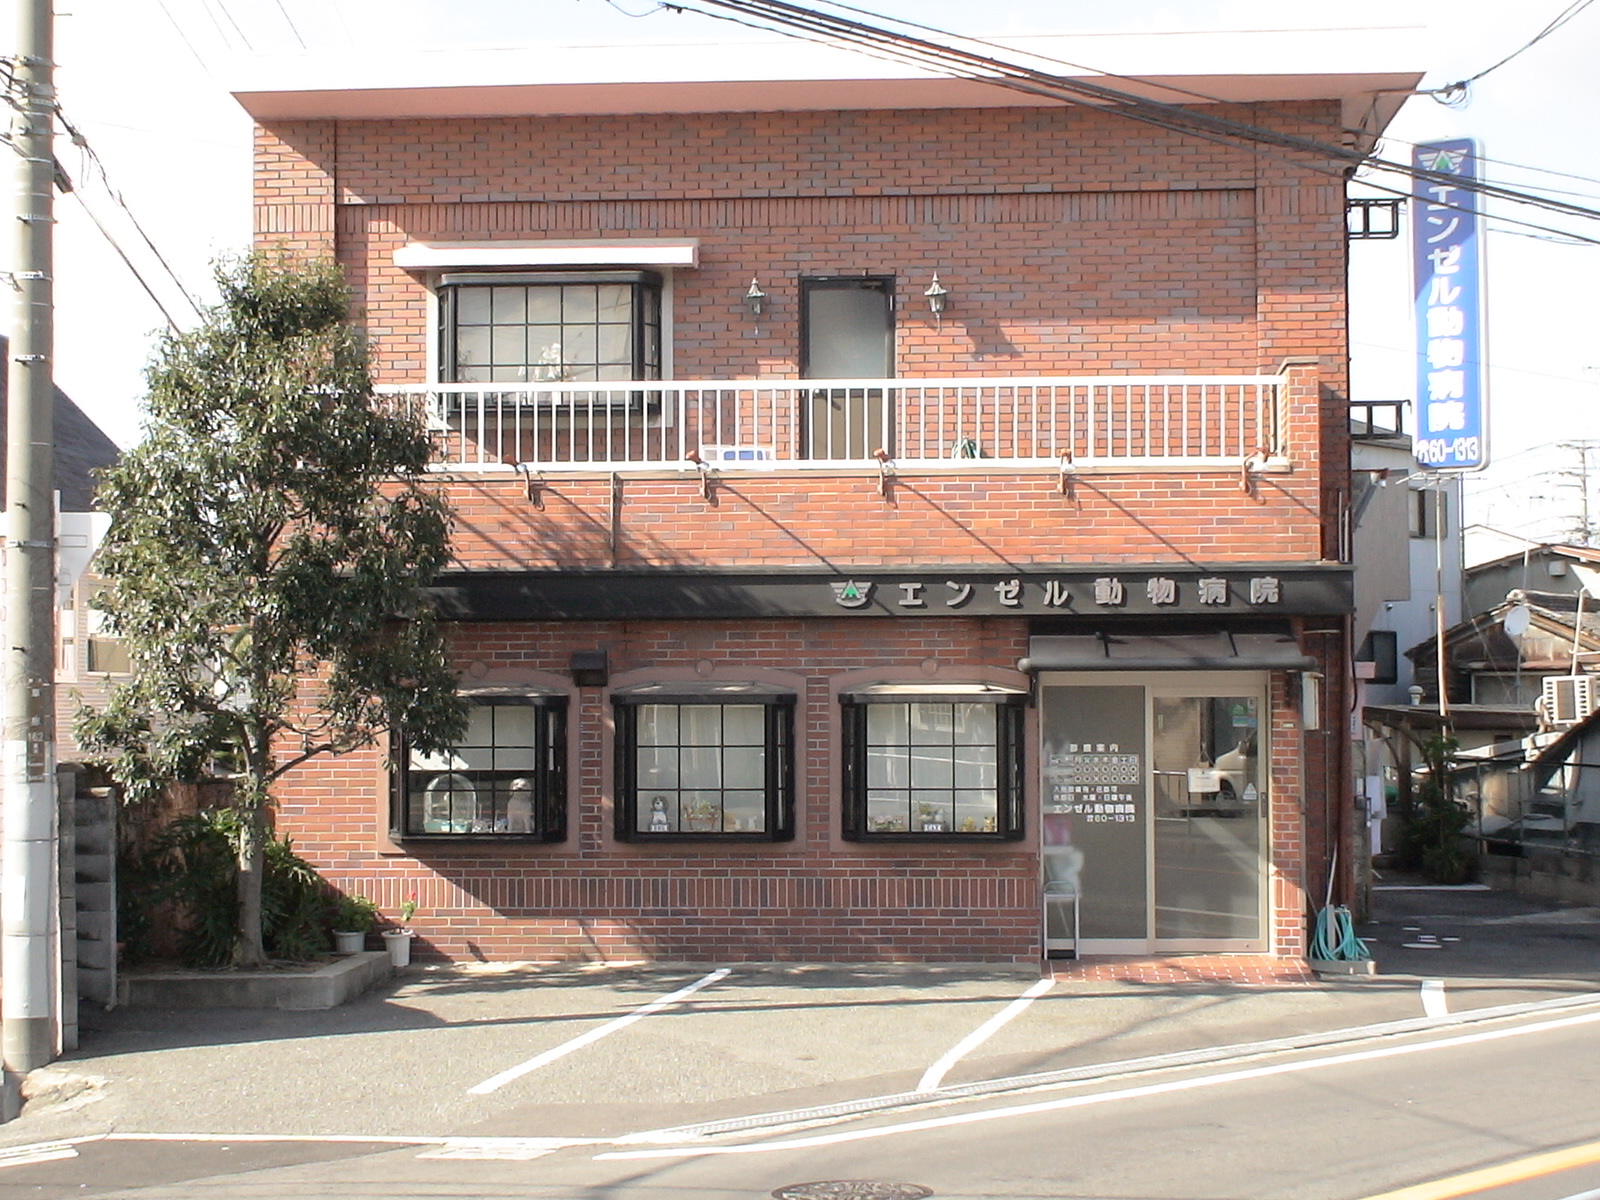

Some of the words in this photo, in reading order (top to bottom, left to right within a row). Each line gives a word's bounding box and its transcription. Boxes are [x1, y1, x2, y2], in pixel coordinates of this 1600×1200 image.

[898, 576, 1280, 606] エンゼル動物病院
